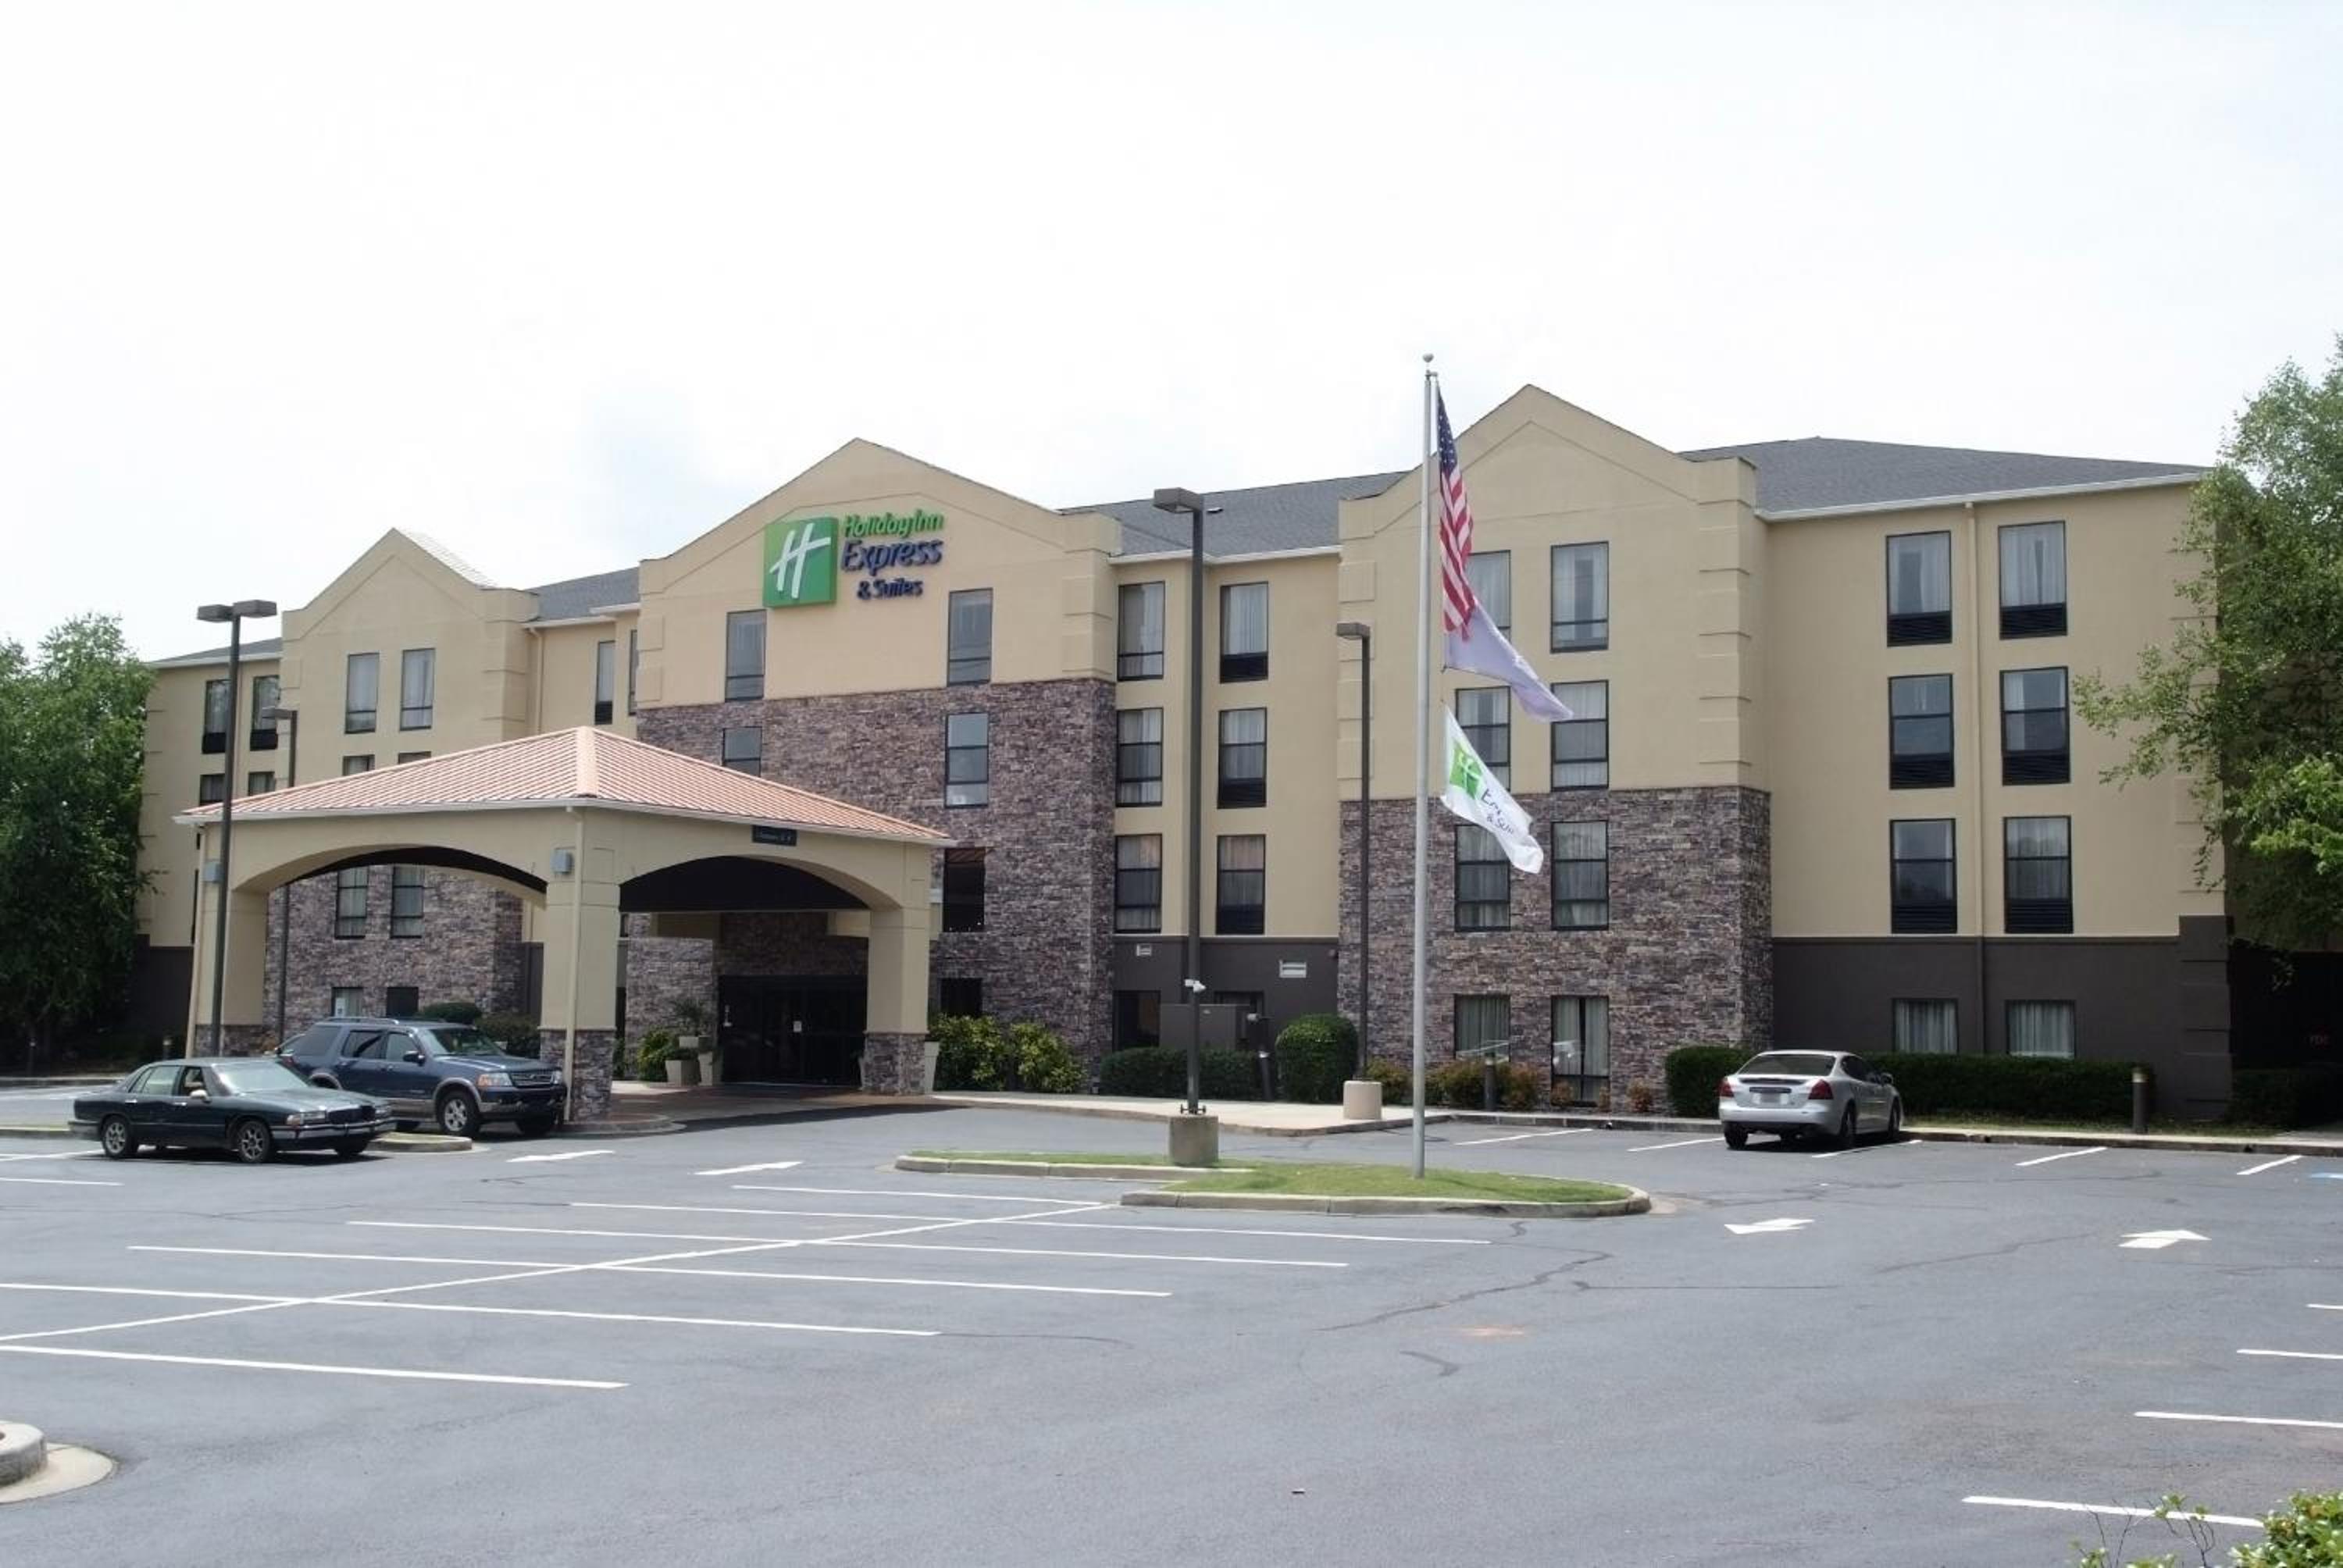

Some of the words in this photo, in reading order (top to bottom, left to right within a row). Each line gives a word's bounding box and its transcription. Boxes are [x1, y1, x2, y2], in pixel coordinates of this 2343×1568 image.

[844, 512, 912, 538] Holiday
[913, 509, 944, 533] Inn
[841, 539, 944, 576] Express
[858, 579, 872, 600] &
[872, 577, 924, 598] Suites
